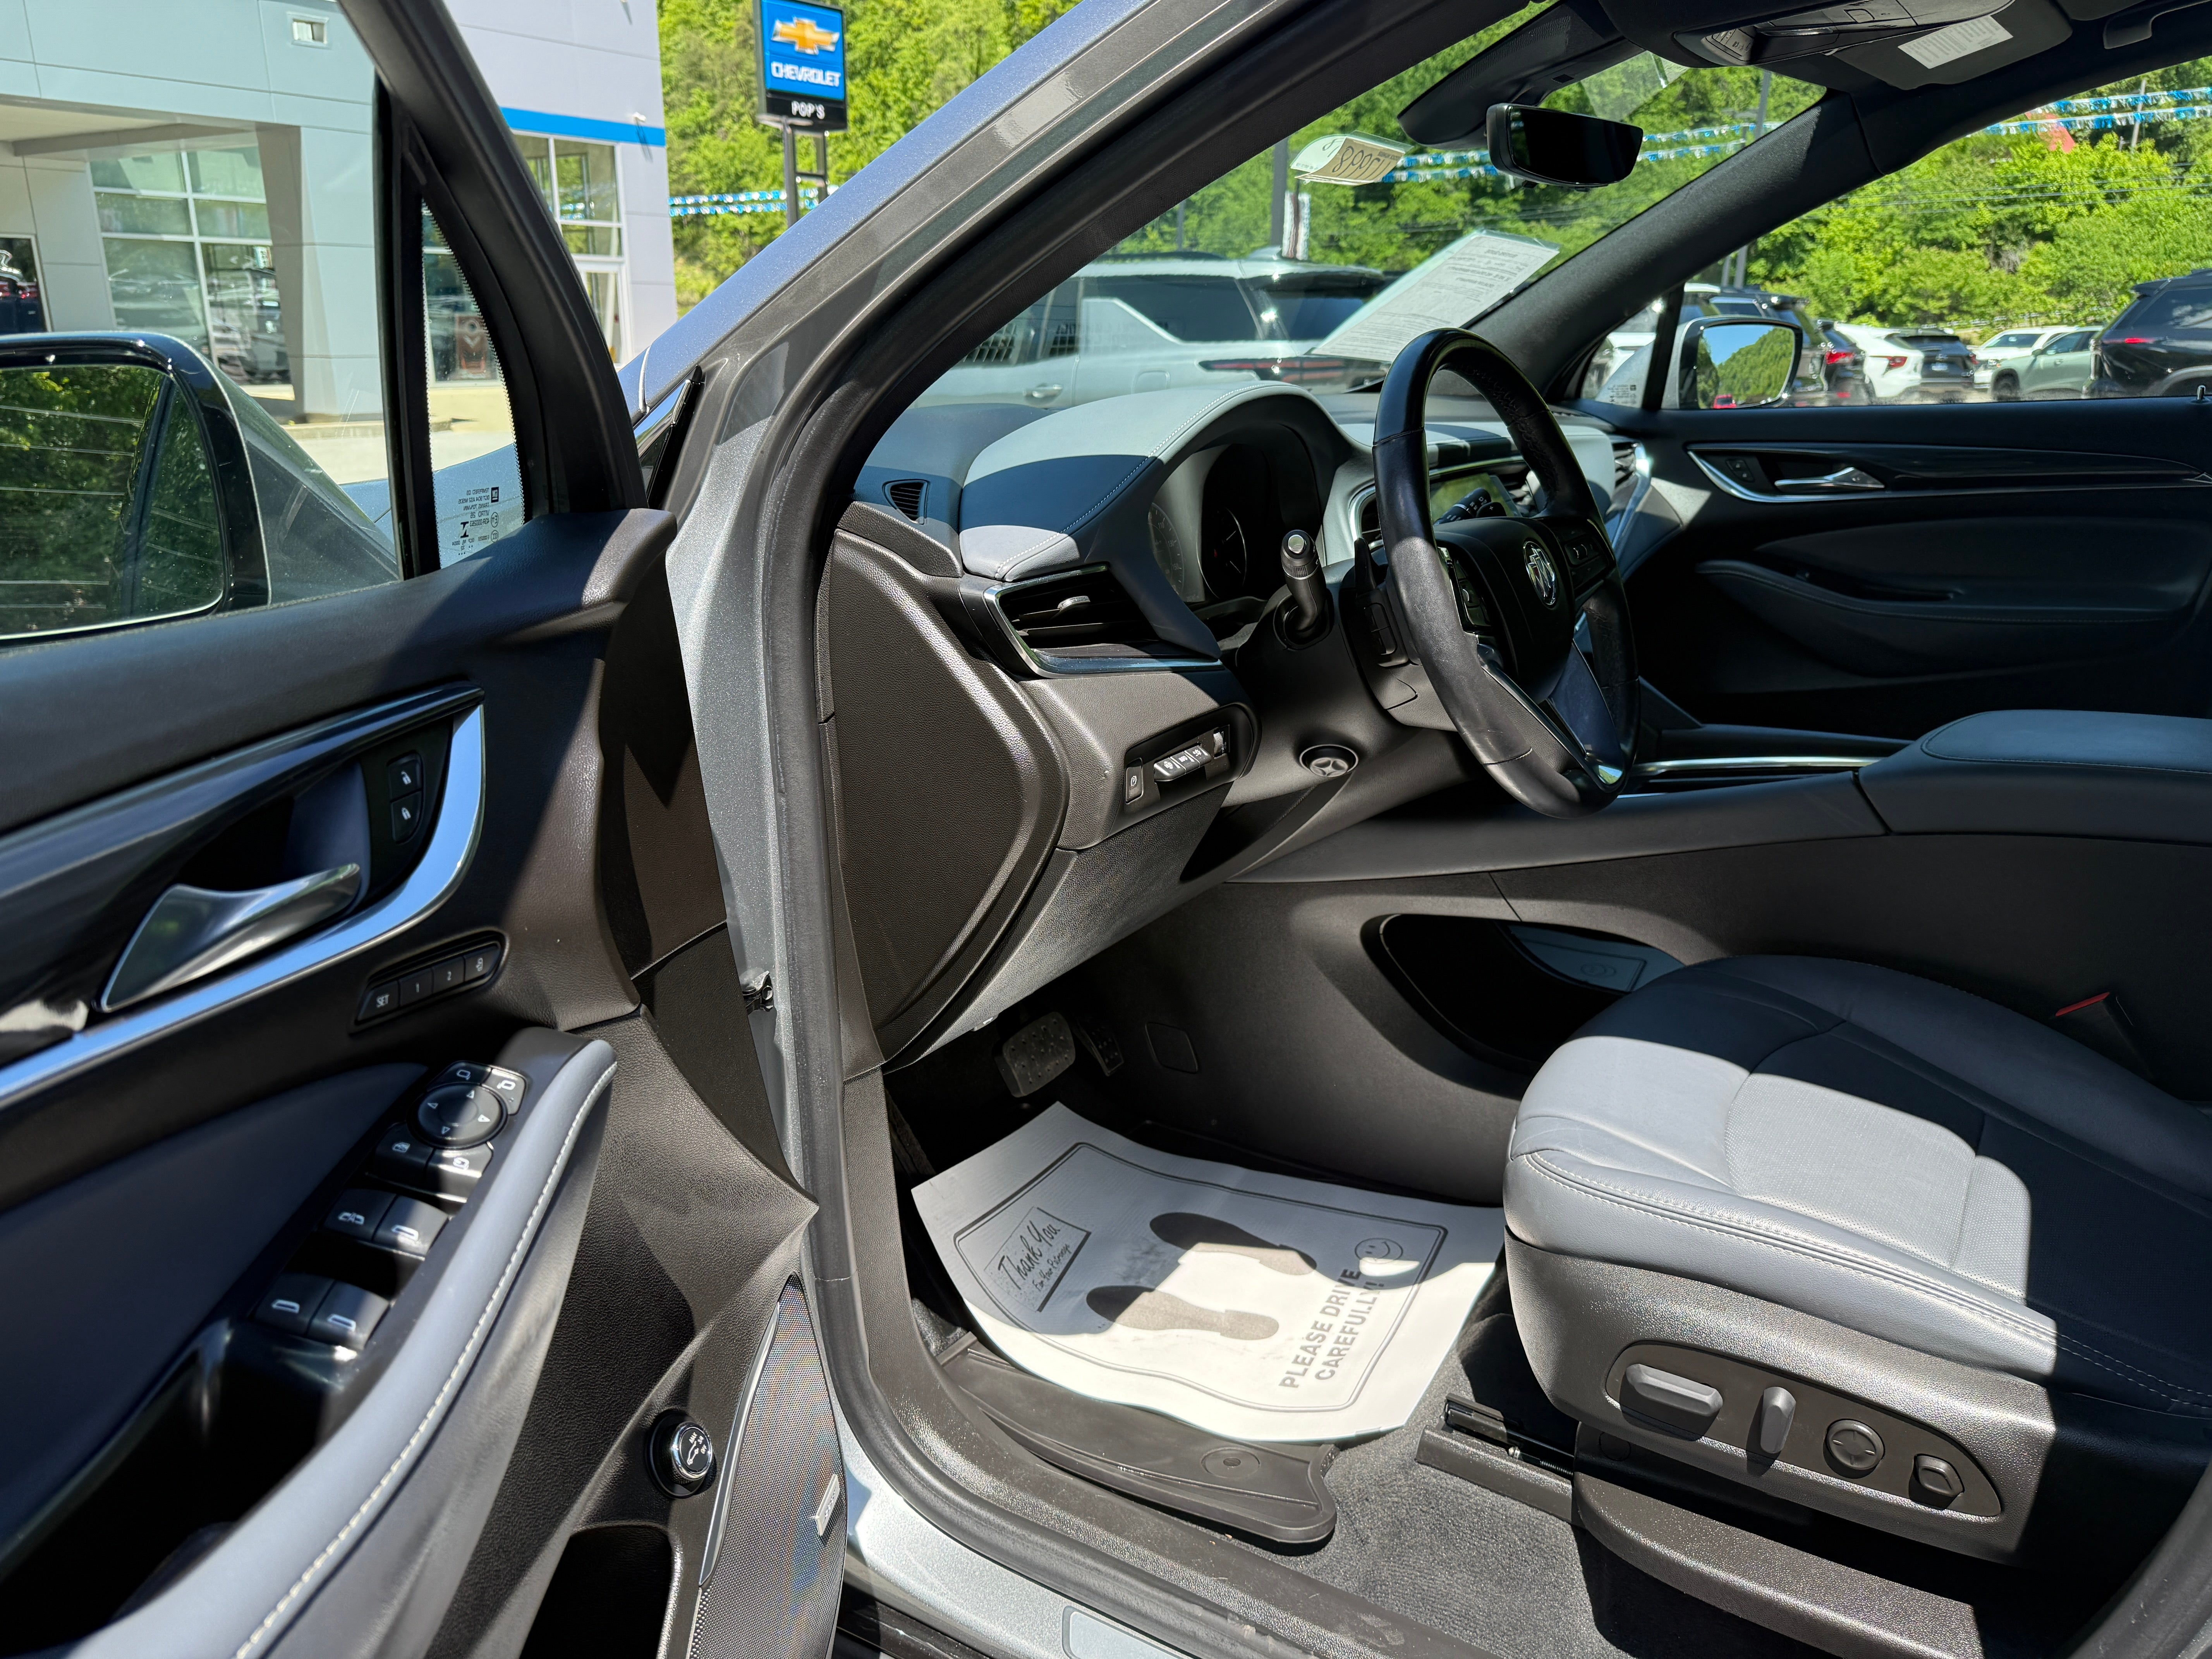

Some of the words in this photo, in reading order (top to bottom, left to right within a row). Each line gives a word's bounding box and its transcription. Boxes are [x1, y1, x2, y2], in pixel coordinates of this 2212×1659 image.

[771, 61, 841, 87] CHEVROLET
[791, 100, 825, 120] POP'S
[376, 994, 390, 1008] SET
[447, 971, 452, 981] 2
[998, 1235, 1042, 1290] Thank
[1026, 1220, 1061, 1247] You
[1278, 1320, 1333, 1388] PLEASE
[1319, 1269, 1361, 1317] DRIVE
[1314, 1281, 1385, 1381] CAREFULLY!
